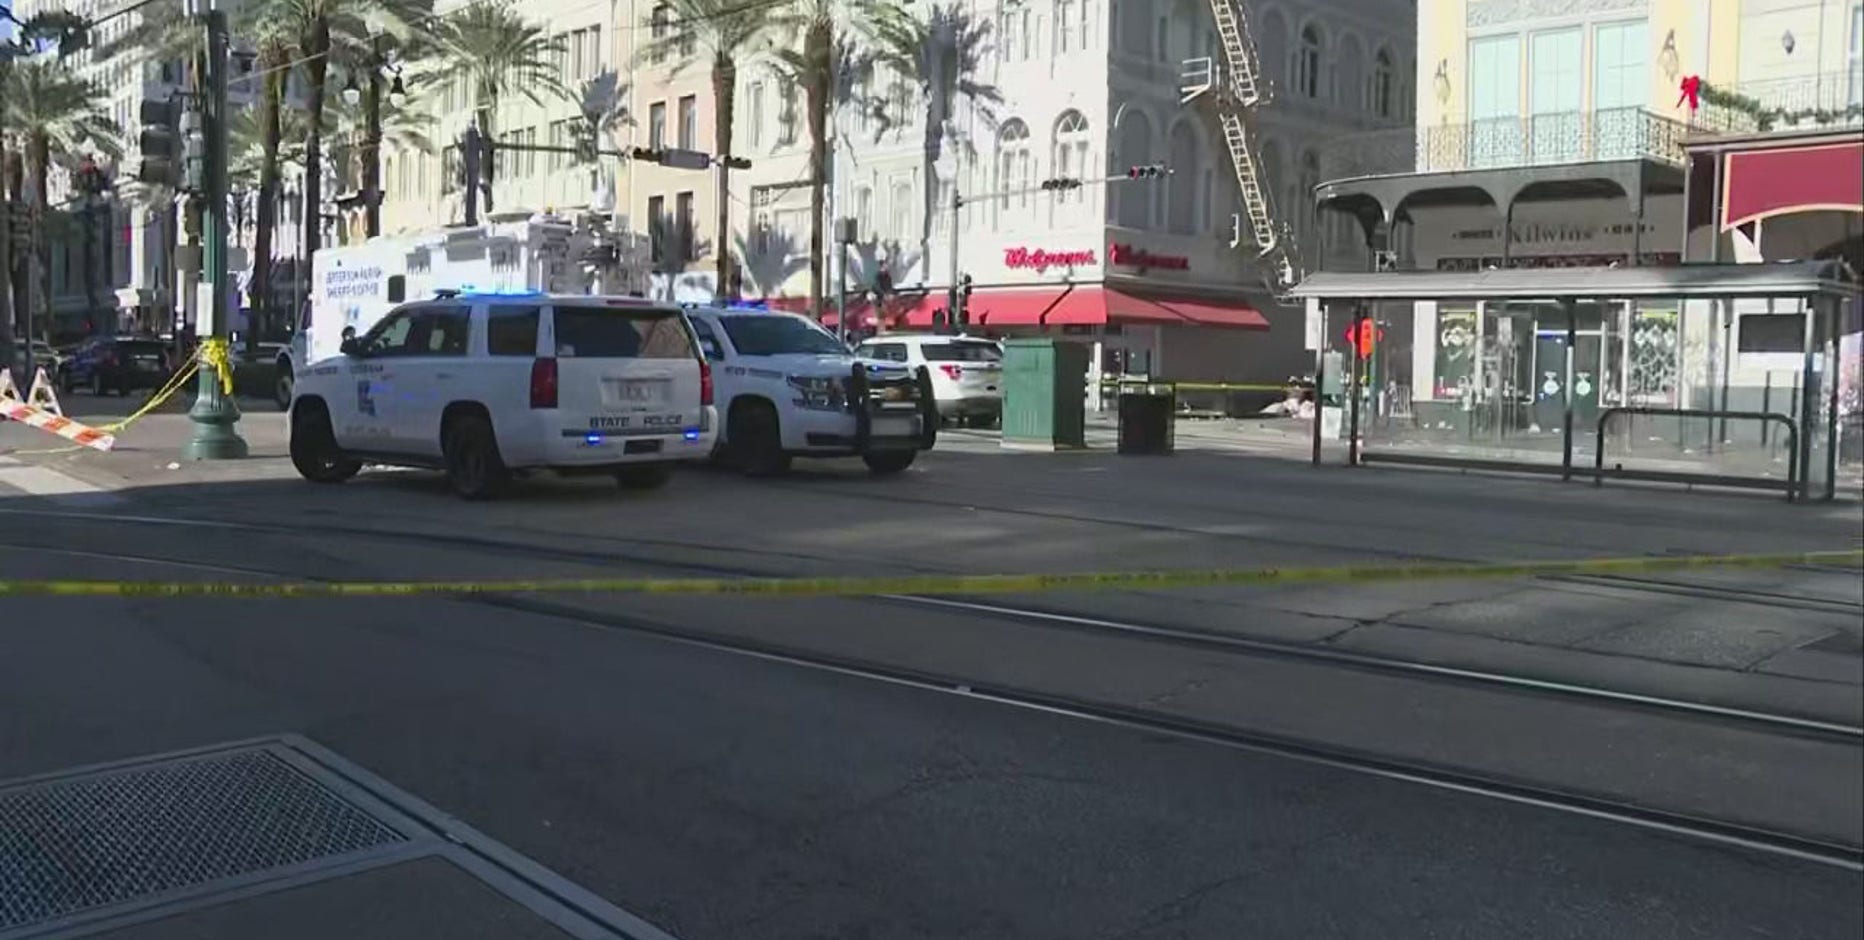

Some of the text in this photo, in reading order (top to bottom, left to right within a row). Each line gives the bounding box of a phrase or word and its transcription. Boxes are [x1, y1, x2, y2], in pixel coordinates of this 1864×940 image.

[1004, 247, 1097, 273] Walgreens
[590, 414, 682, 427] STATE POLICE
